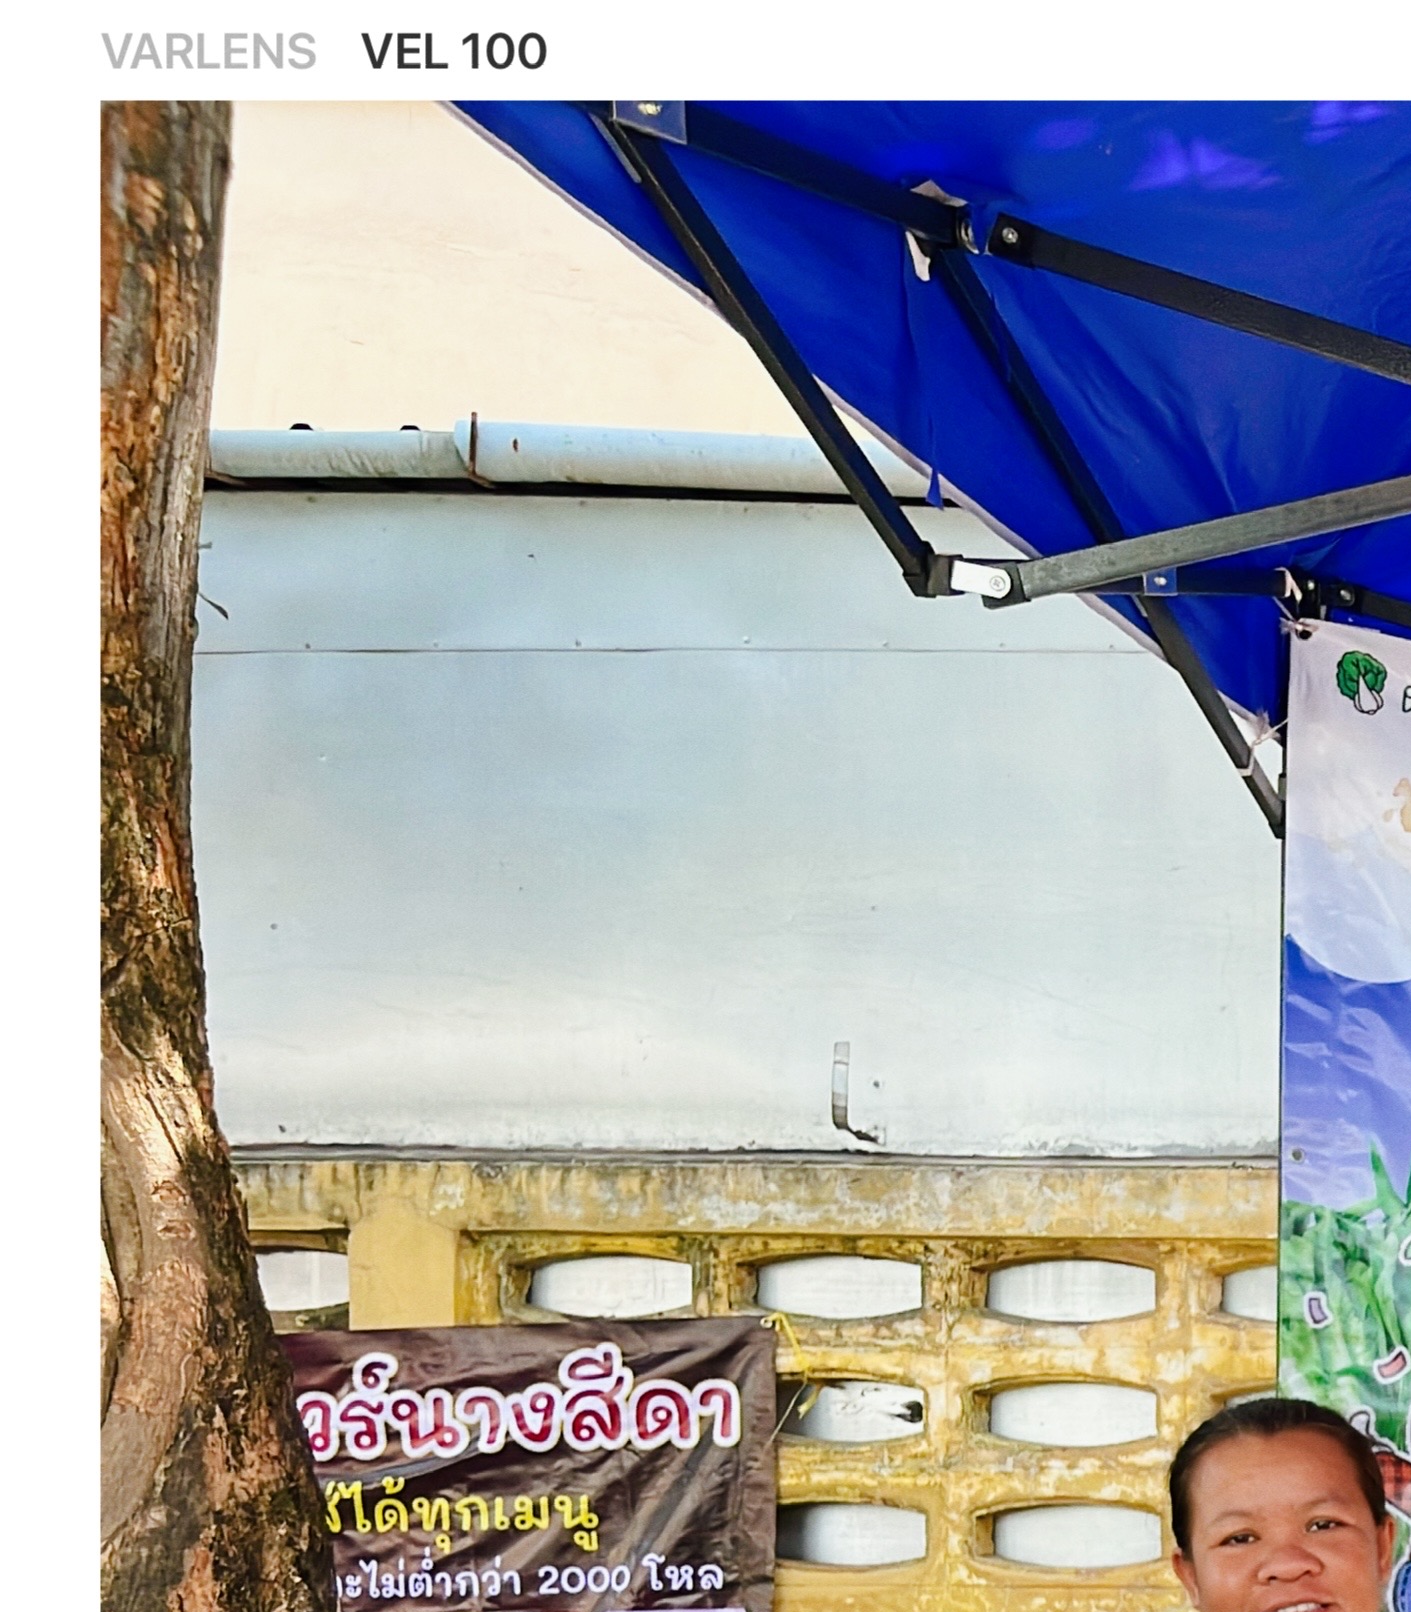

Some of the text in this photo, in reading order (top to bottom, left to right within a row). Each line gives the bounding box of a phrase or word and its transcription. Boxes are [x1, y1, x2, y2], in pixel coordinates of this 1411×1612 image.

[297, 1342, 743, 1462] วร์นางสีดา
[325, 1475, 600, 1554] ได้ทุกเมนู
[335, 1548, 725, 1600] ะไม่ต่ำกว่า 2000 โหล
